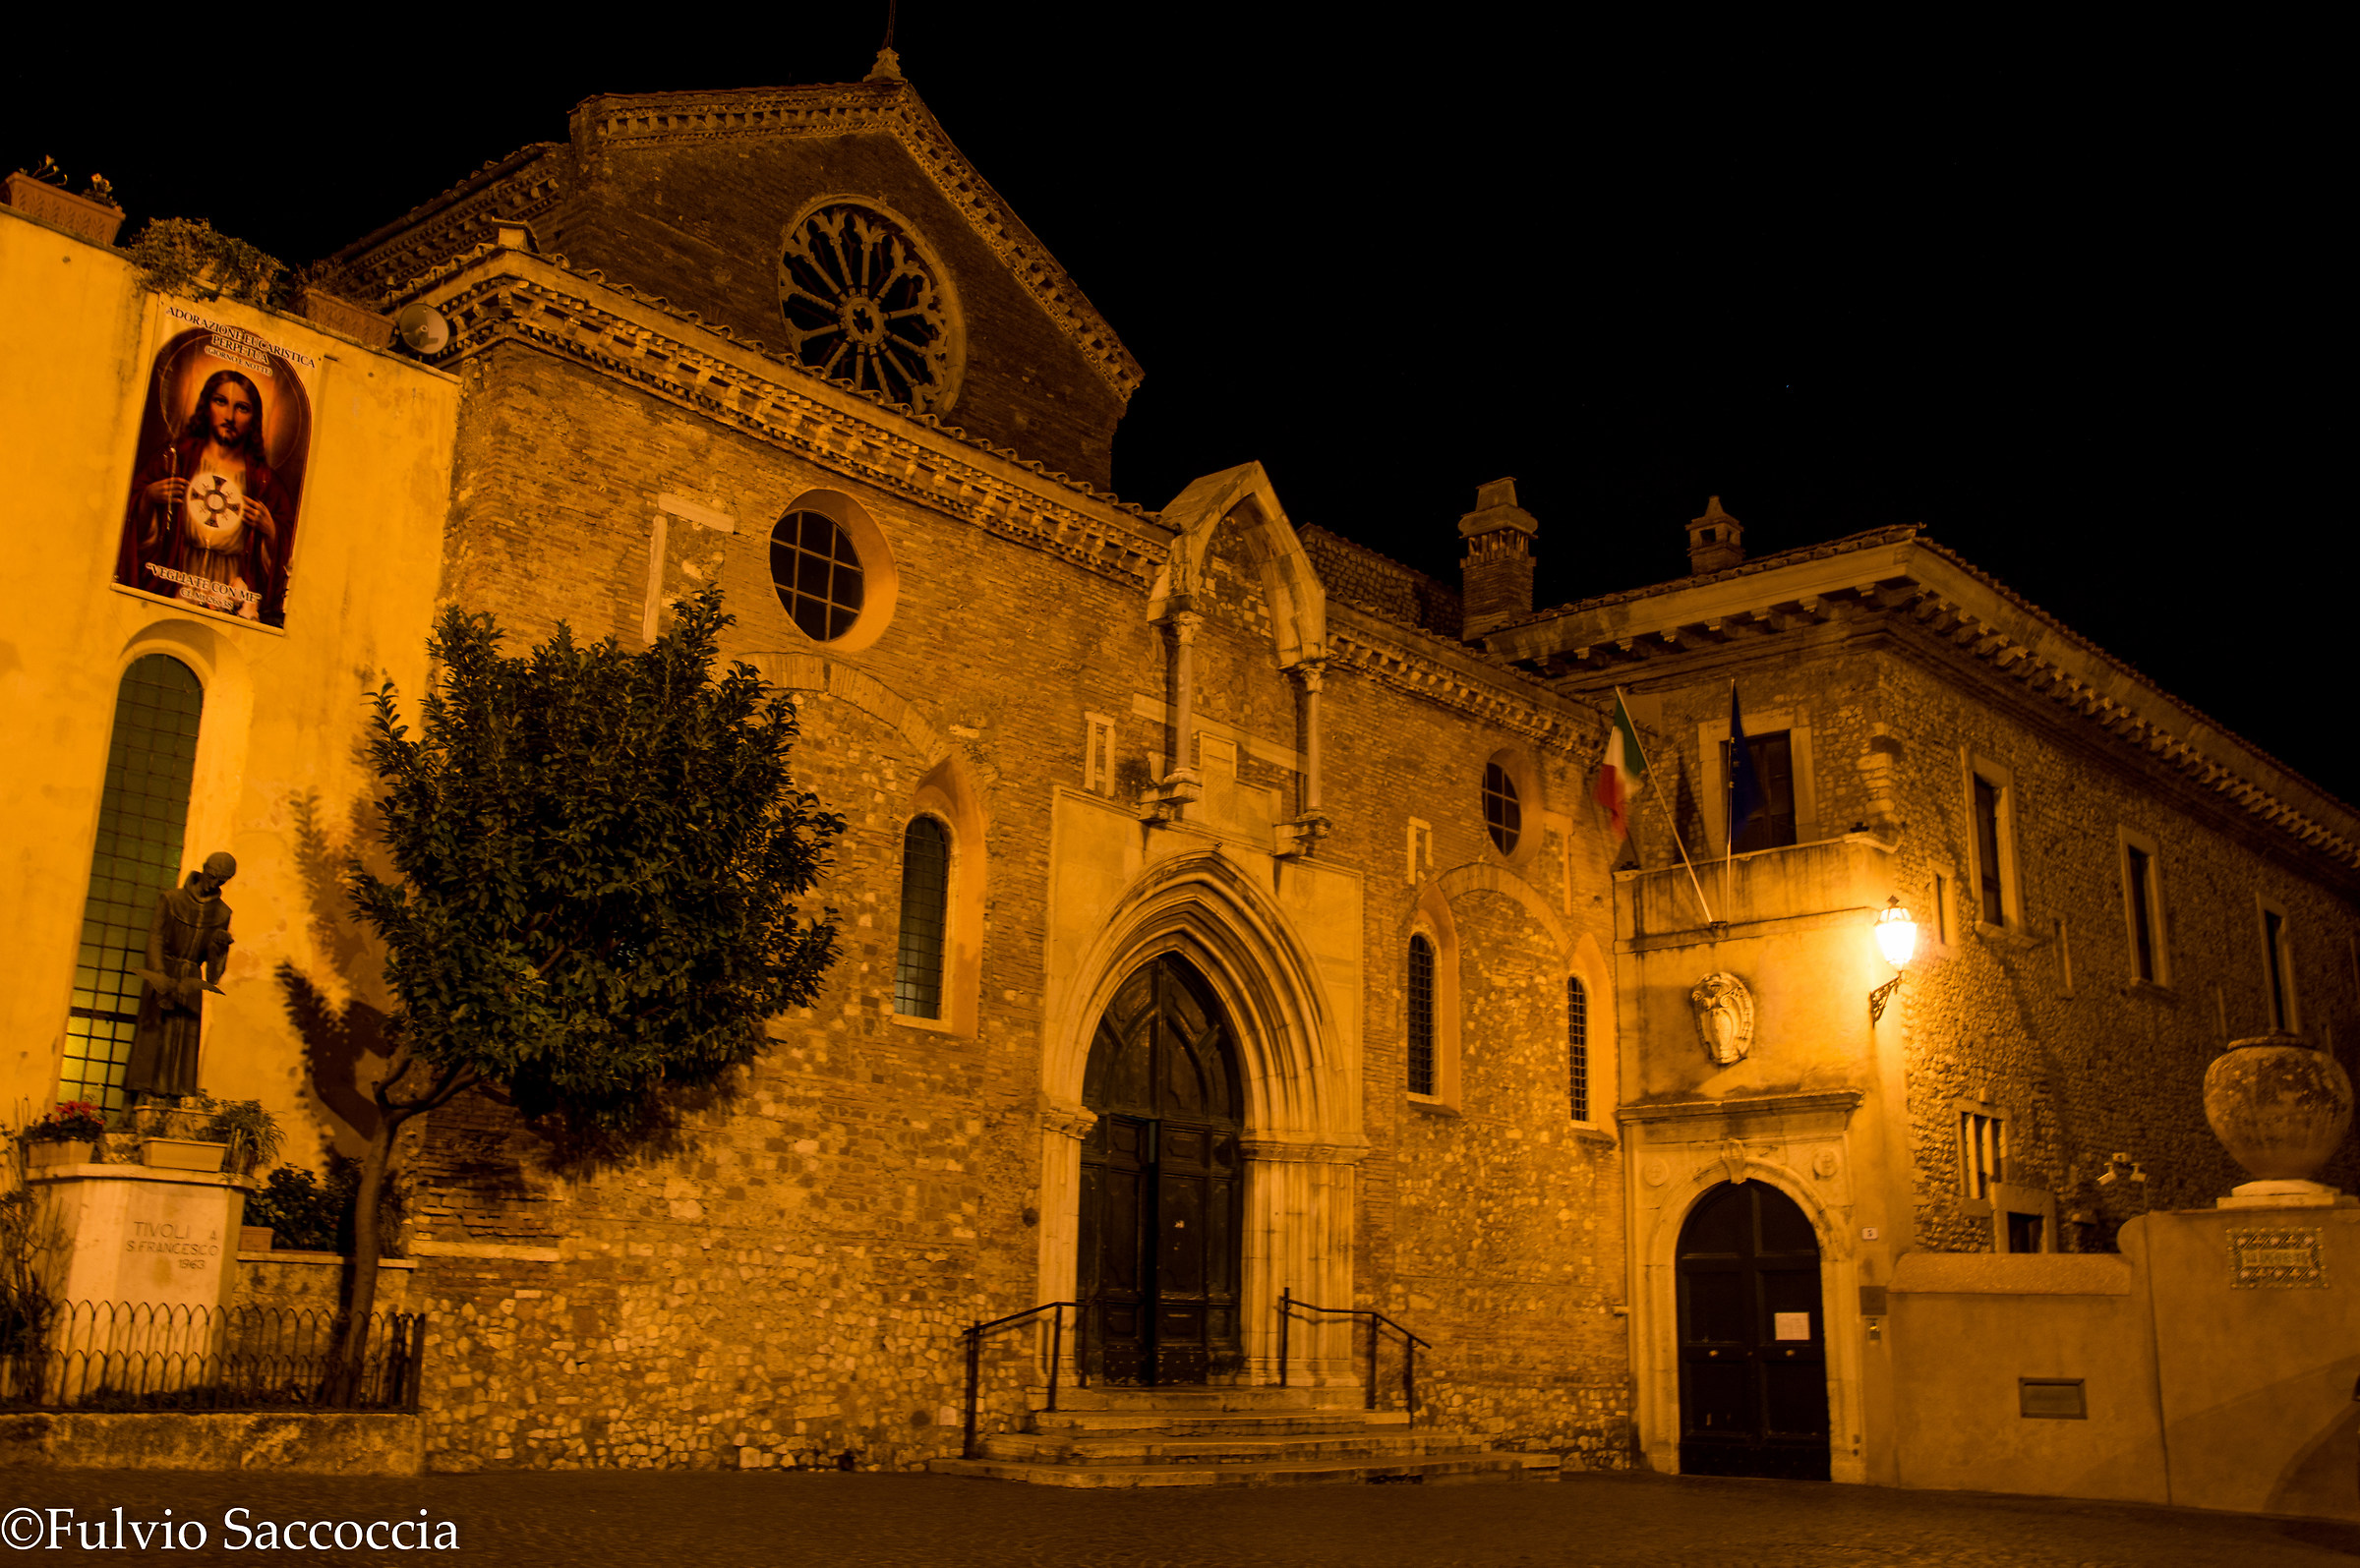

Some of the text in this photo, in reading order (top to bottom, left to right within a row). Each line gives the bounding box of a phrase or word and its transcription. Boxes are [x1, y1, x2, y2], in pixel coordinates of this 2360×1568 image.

[166, 306, 316, 369] ADORAZIONE EUCARISTICA
[211, 334, 269, 364] PERPETUA
[206, 346, 238, 366] (GIORNO
[245, 361, 272, 376] NOTTE)
[211, 581, 237, 598] CON
[134, 1221, 217, 1241] TIVOLI A
[178, 1258, 206, 1270] 1963
